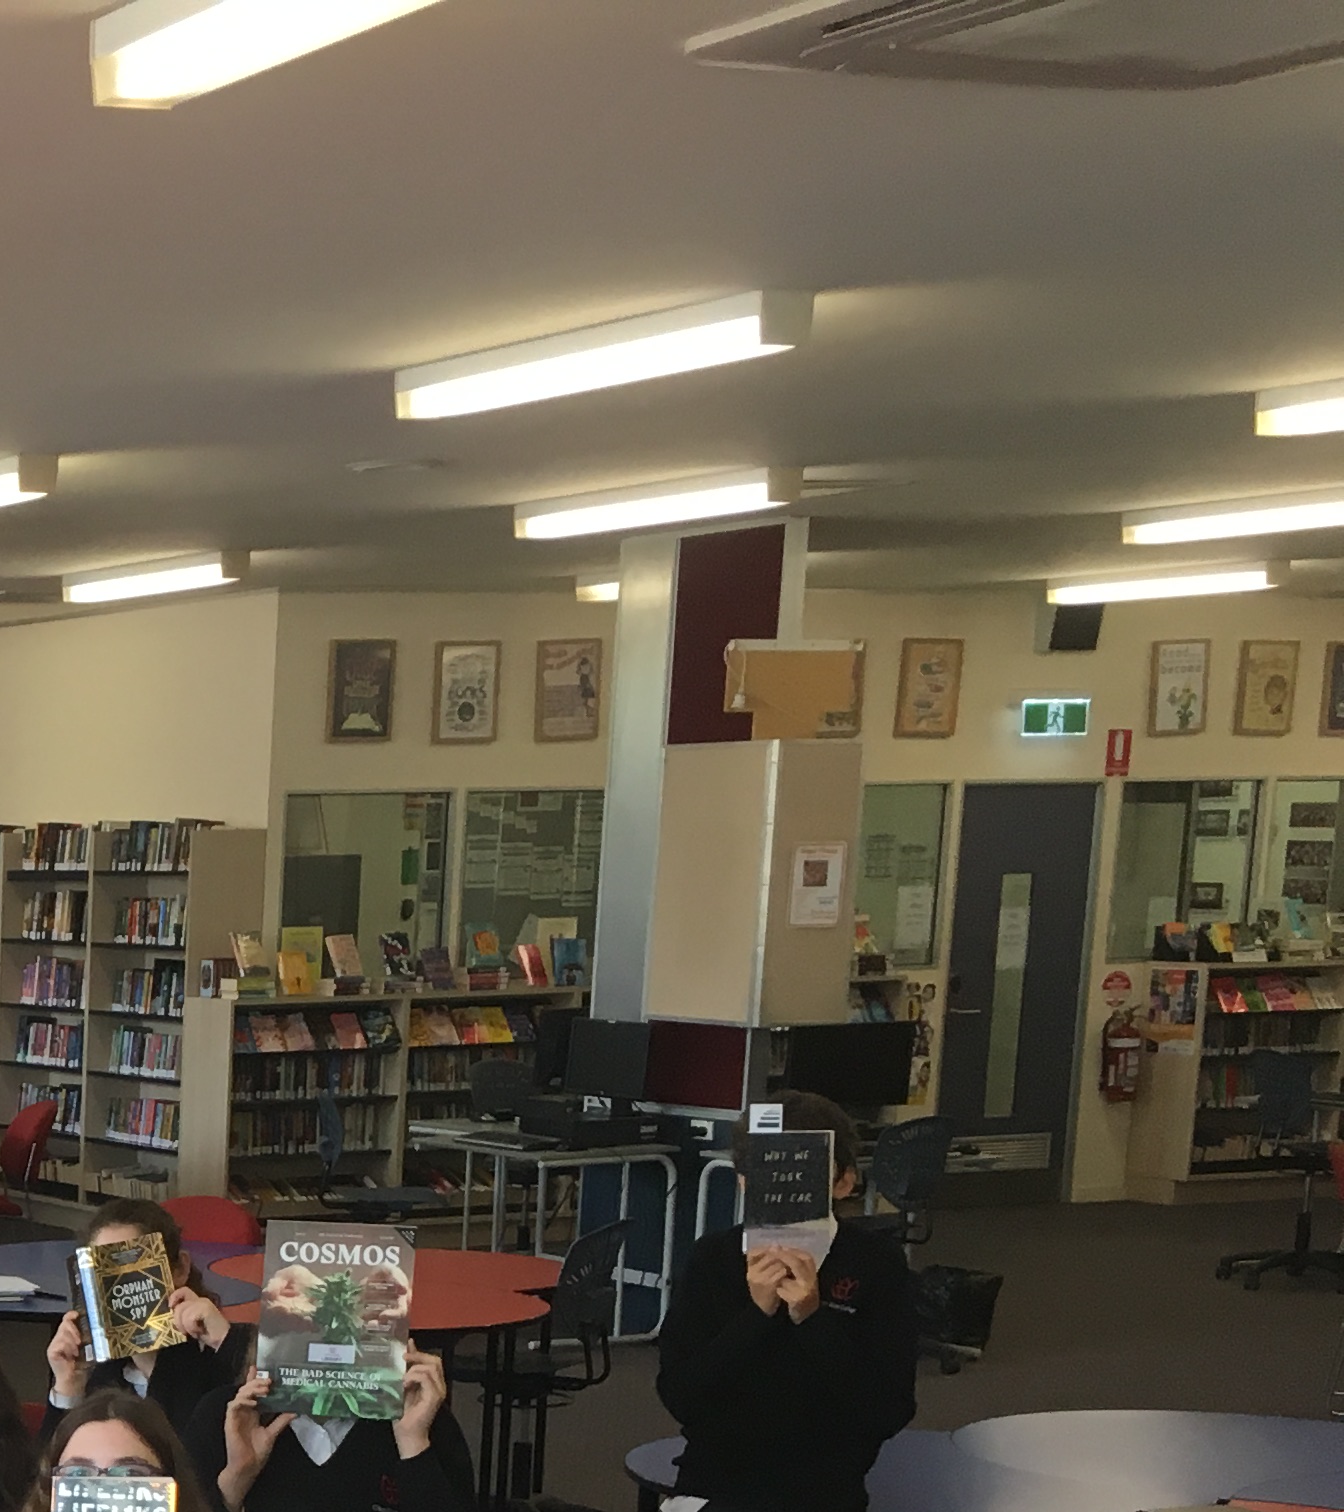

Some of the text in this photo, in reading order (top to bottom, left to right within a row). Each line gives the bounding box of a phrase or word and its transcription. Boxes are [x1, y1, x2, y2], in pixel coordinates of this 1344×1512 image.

[772, 1171, 803, 1182] TOOK
[764, 1193, 812, 1204] THE CAR
[279, 1241, 401, 1266] COSMOS
[112, 1279, 155, 1298] ORPHAN
[112, 1290, 161, 1309] MONSTER
[129, 1304, 148, 1321] SPY
[279, 1367, 299, 1377] THE
[301, 1368, 323, 1379] BAD
[325, 1370, 365, 1380] SCIENCE
[281, 1377, 379, 1391] MEDICAL CANNABIS
